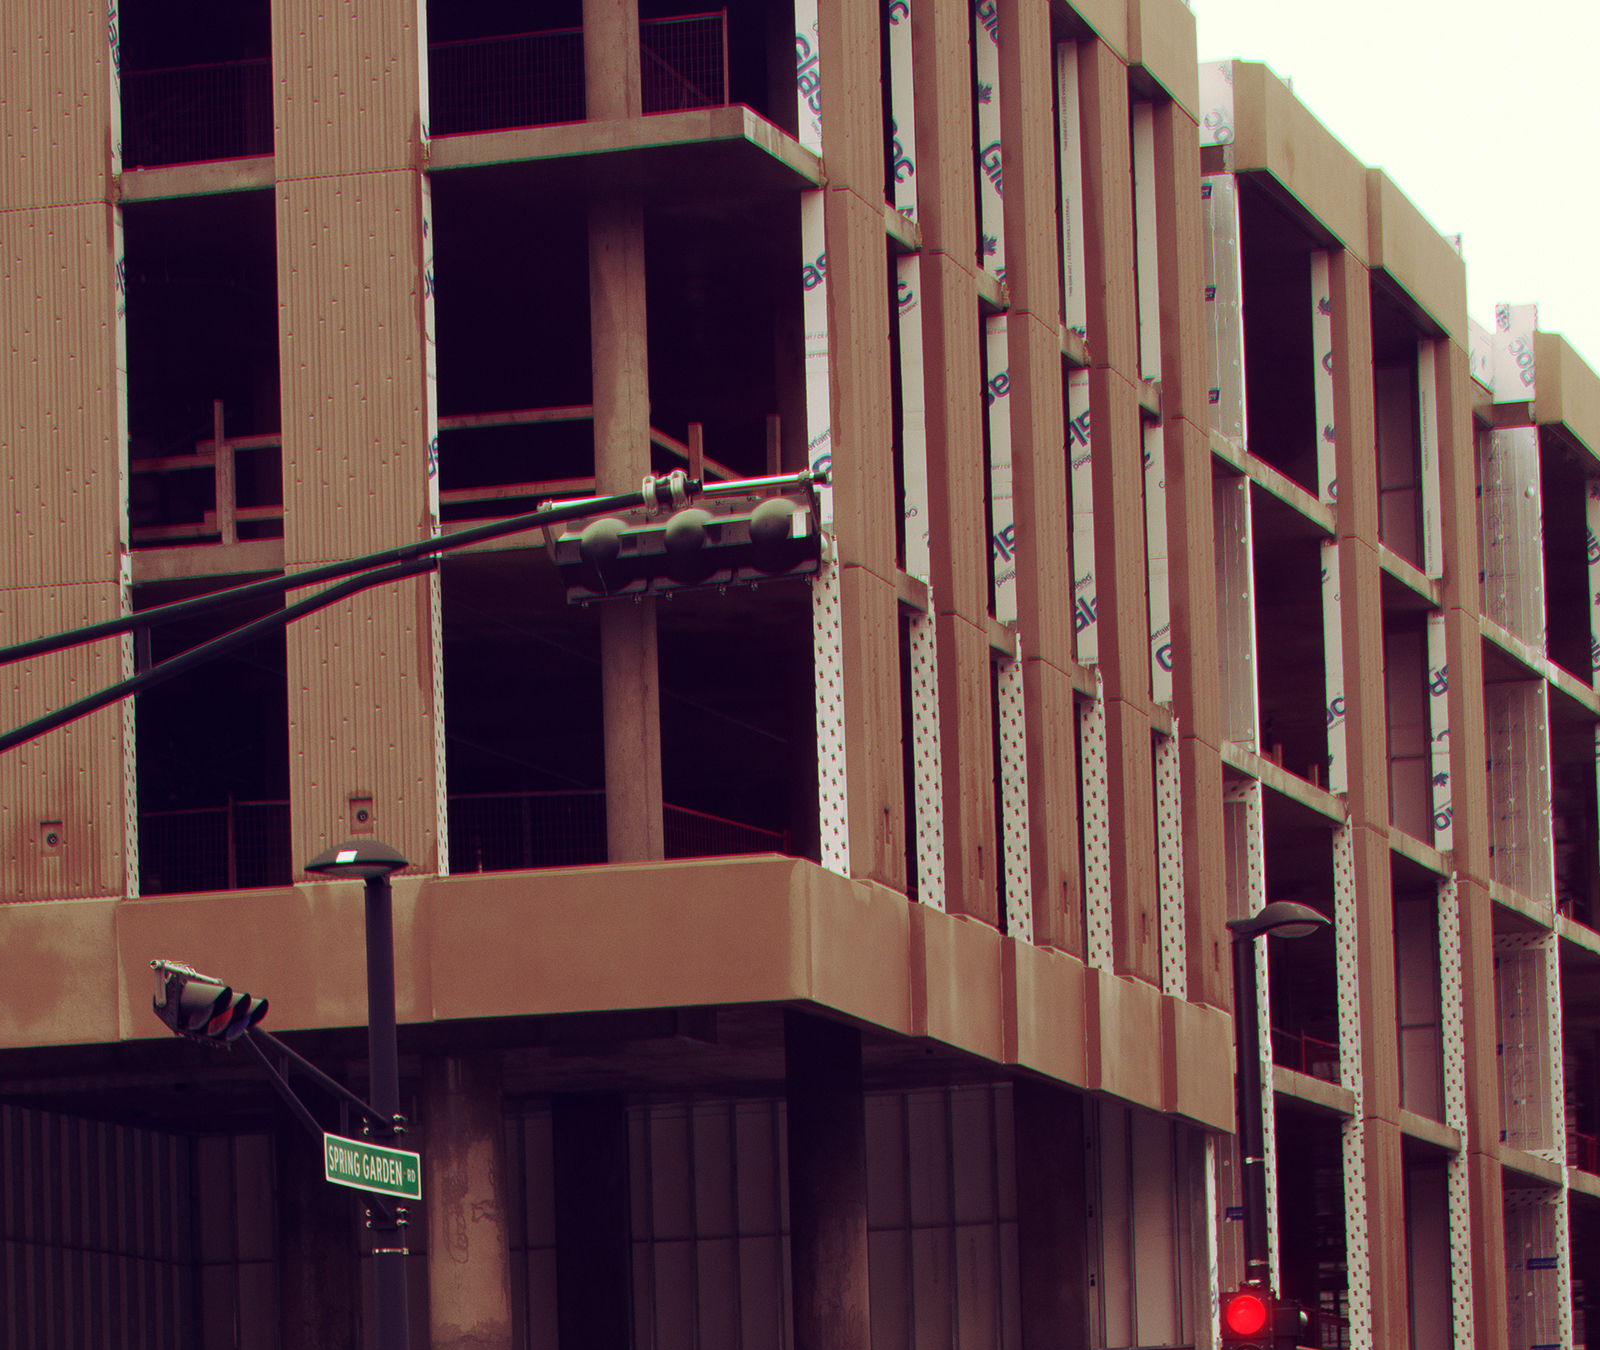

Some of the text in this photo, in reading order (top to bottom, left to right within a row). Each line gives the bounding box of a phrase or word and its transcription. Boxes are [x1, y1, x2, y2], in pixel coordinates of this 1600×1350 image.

[328, 1144, 416, 1187] SPRING GARDEN RD
